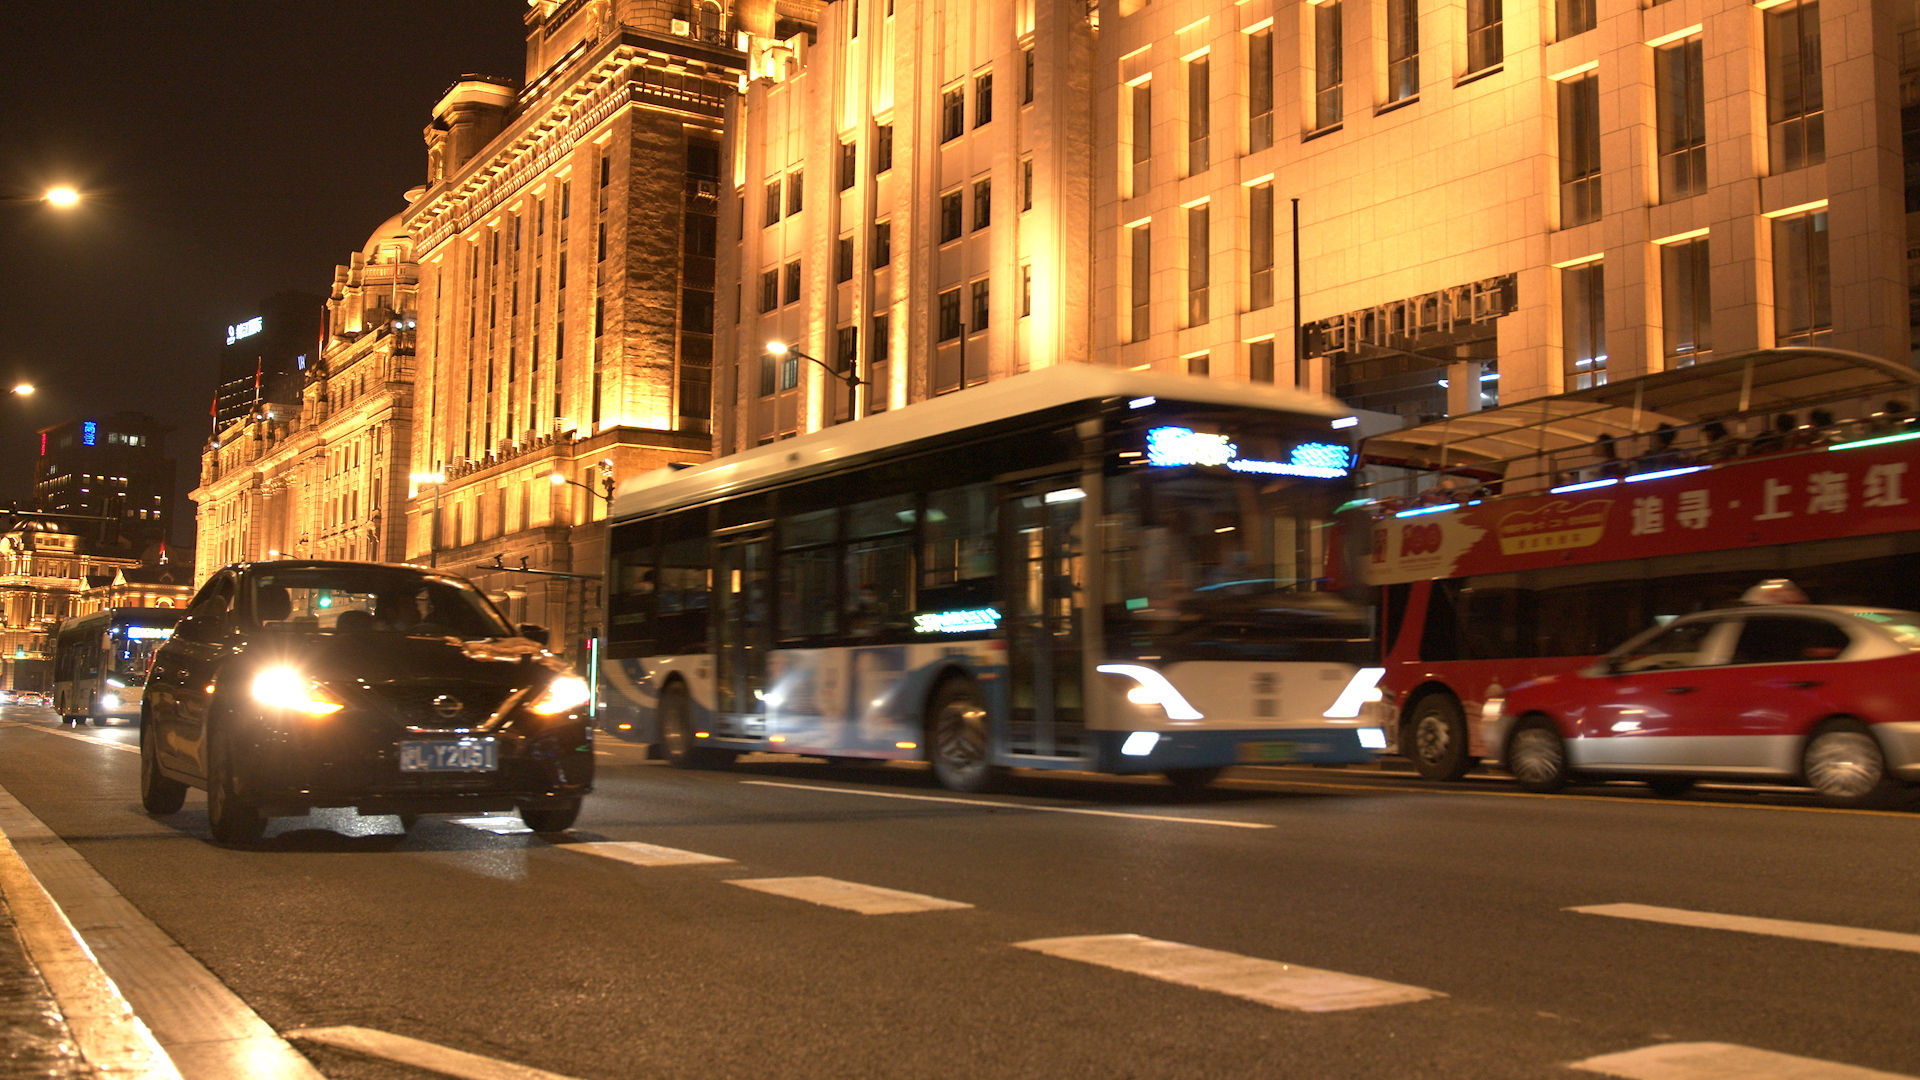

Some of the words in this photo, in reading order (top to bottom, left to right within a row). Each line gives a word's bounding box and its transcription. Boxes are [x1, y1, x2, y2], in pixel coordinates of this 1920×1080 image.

[1630, 461, 1909, 537] 追寻·上海红
